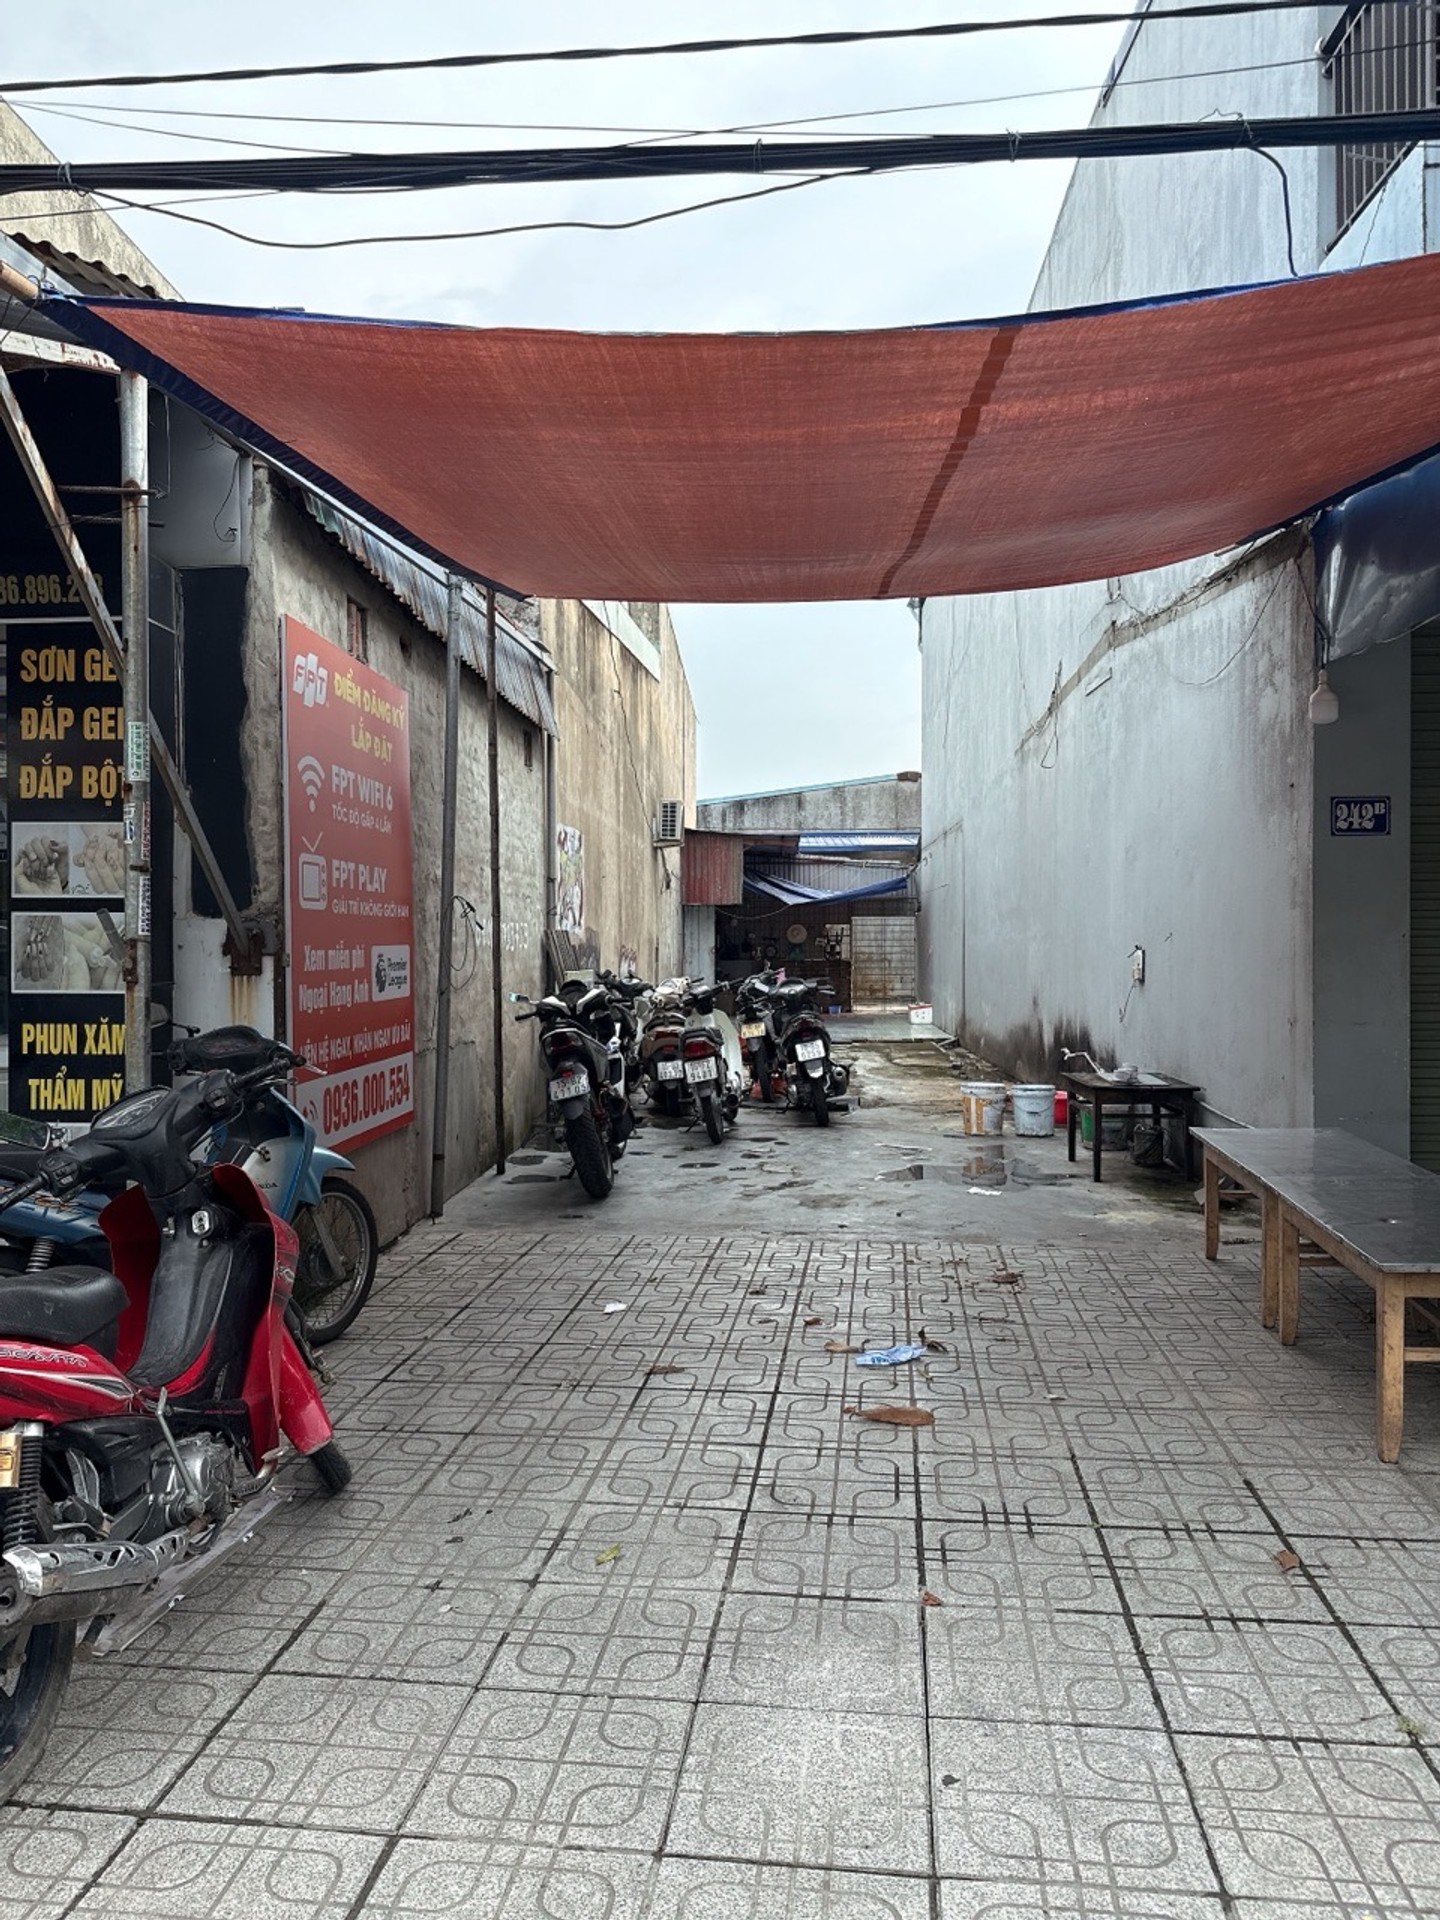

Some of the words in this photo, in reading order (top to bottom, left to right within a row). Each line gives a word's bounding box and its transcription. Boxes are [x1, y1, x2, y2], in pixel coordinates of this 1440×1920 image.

[20, 645, 76, 682] SƠN
[84, 648, 117, 682] GE
[294, 656, 327, 703] FPT
[20, 694, 74, 741] ĐẮP
[392, 705, 404, 730] KÝ
[351, 716, 371, 752] LẮP
[373, 735, 393, 766] ĐẶT
[19, 753, 73, 799] ĐẮP
[331, 764, 355, 798] FPT
[357, 774, 384, 809] WIFI
[386, 786, 393, 811] 6
[331, 859, 355, 888] FPT
[358, 864, 387, 894] PLAY
[304, 945, 326, 971] Xem
[299, 982, 328, 1015] Ngoại
[330, 981, 352, 1012] Hạng
[354, 979, 369, 1004] Anh
[22, 1023, 78, 1055] PHUN
[28, 1065, 86, 1110] THẨM
[323, 1063, 410, 1135] 0936.000.554
